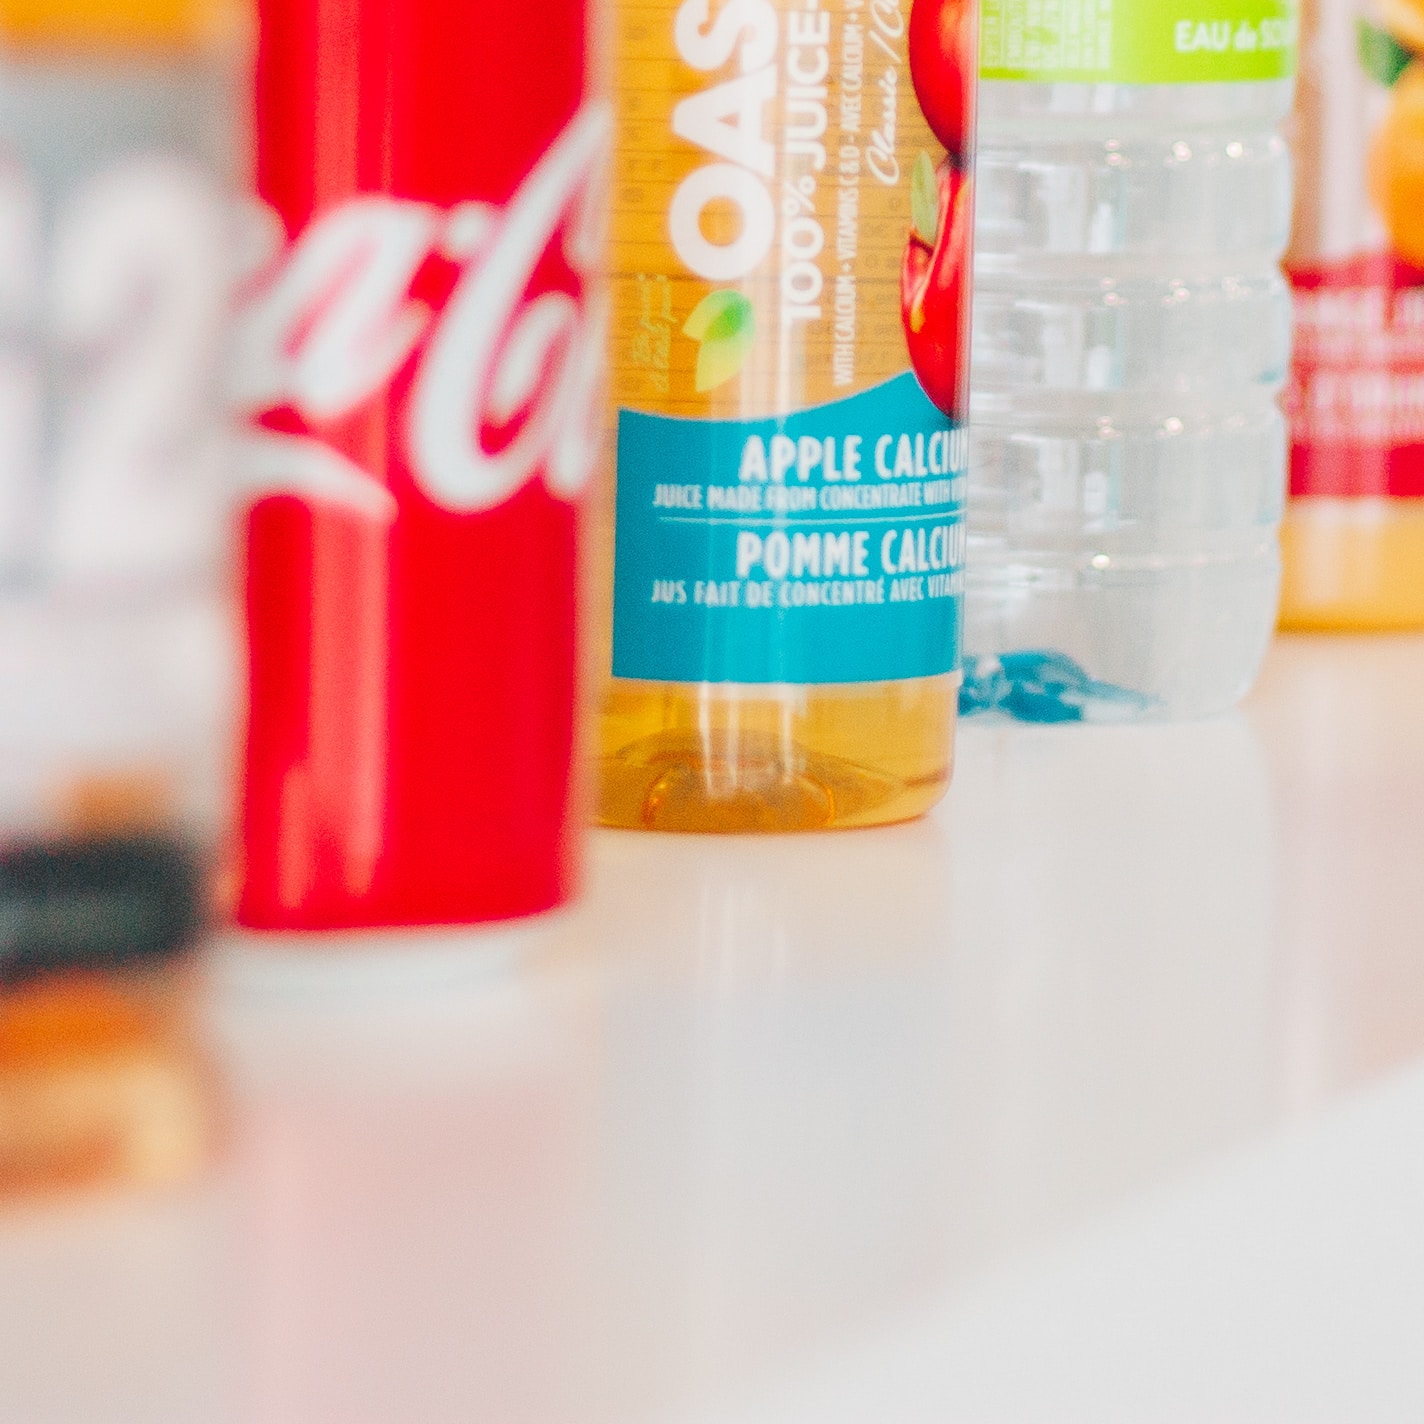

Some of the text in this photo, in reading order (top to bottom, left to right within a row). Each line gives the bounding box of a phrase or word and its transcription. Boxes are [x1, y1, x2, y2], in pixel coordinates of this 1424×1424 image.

[841, 24, 864, 90] CALCIUM
[1174, 19, 1231, 53] EAU
[865, 65, 900, 187] Classic
[780, 175, 825, 323] 100%
[837, 187, 859, 261] VITAMINS
[834, 275, 856, 343] CALCIUM
[833, 344, 855, 386] WITH
[738, 434, 863, 482] APPLE
[652, 483, 703, 509] JUICE
[707, 484, 761, 512] MADE
[764, 484, 817, 511] FROM
[819, 483, 922, 511] CONCENTRATE
[735, 530, 870, 580] POMME
[651, 579, 687, 604] JUS
[693, 579, 740, 608] FAIT
[745, 579, 773, 608] DE
[778, 575, 885, 608] CONCENTRÉ
[890, 576, 924, 602] AVEC
